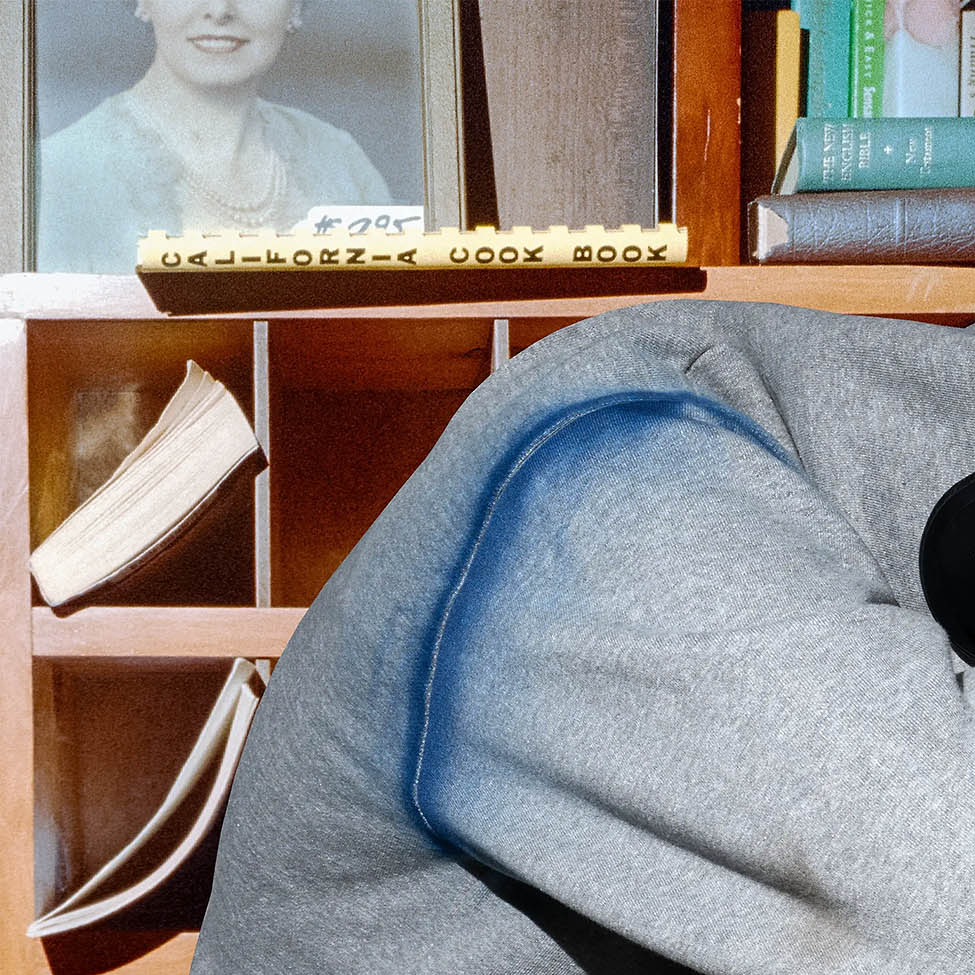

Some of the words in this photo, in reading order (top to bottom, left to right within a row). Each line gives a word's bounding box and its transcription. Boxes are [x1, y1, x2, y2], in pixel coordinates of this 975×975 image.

[823, 123, 836, 150] NEW
[840, 123, 853, 181] ENGLISH
[858, 131, 872, 169] BIBLE
[823, 151, 836, 182] THE
[160, 247, 416, 269] CALIFORNIA
[450, 245, 544, 265] COOK
[572, 243, 669, 264] BOOK
